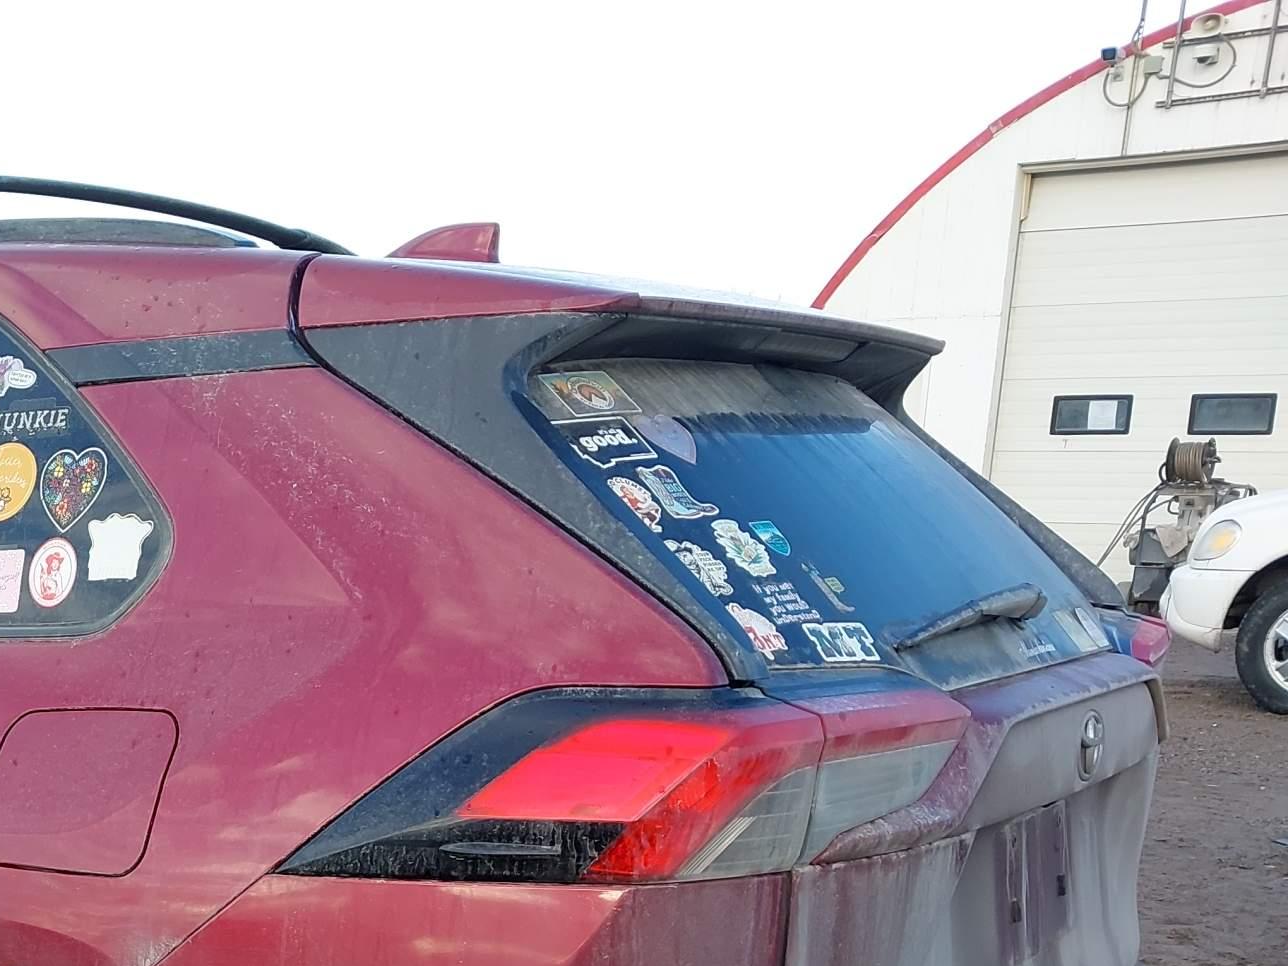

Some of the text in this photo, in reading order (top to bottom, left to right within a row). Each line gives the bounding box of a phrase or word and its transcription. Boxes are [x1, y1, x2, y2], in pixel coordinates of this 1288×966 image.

[762, 584, 779, 595] you
[769, 605, 786, 616] you
[807, 625, 875, 657] MT
